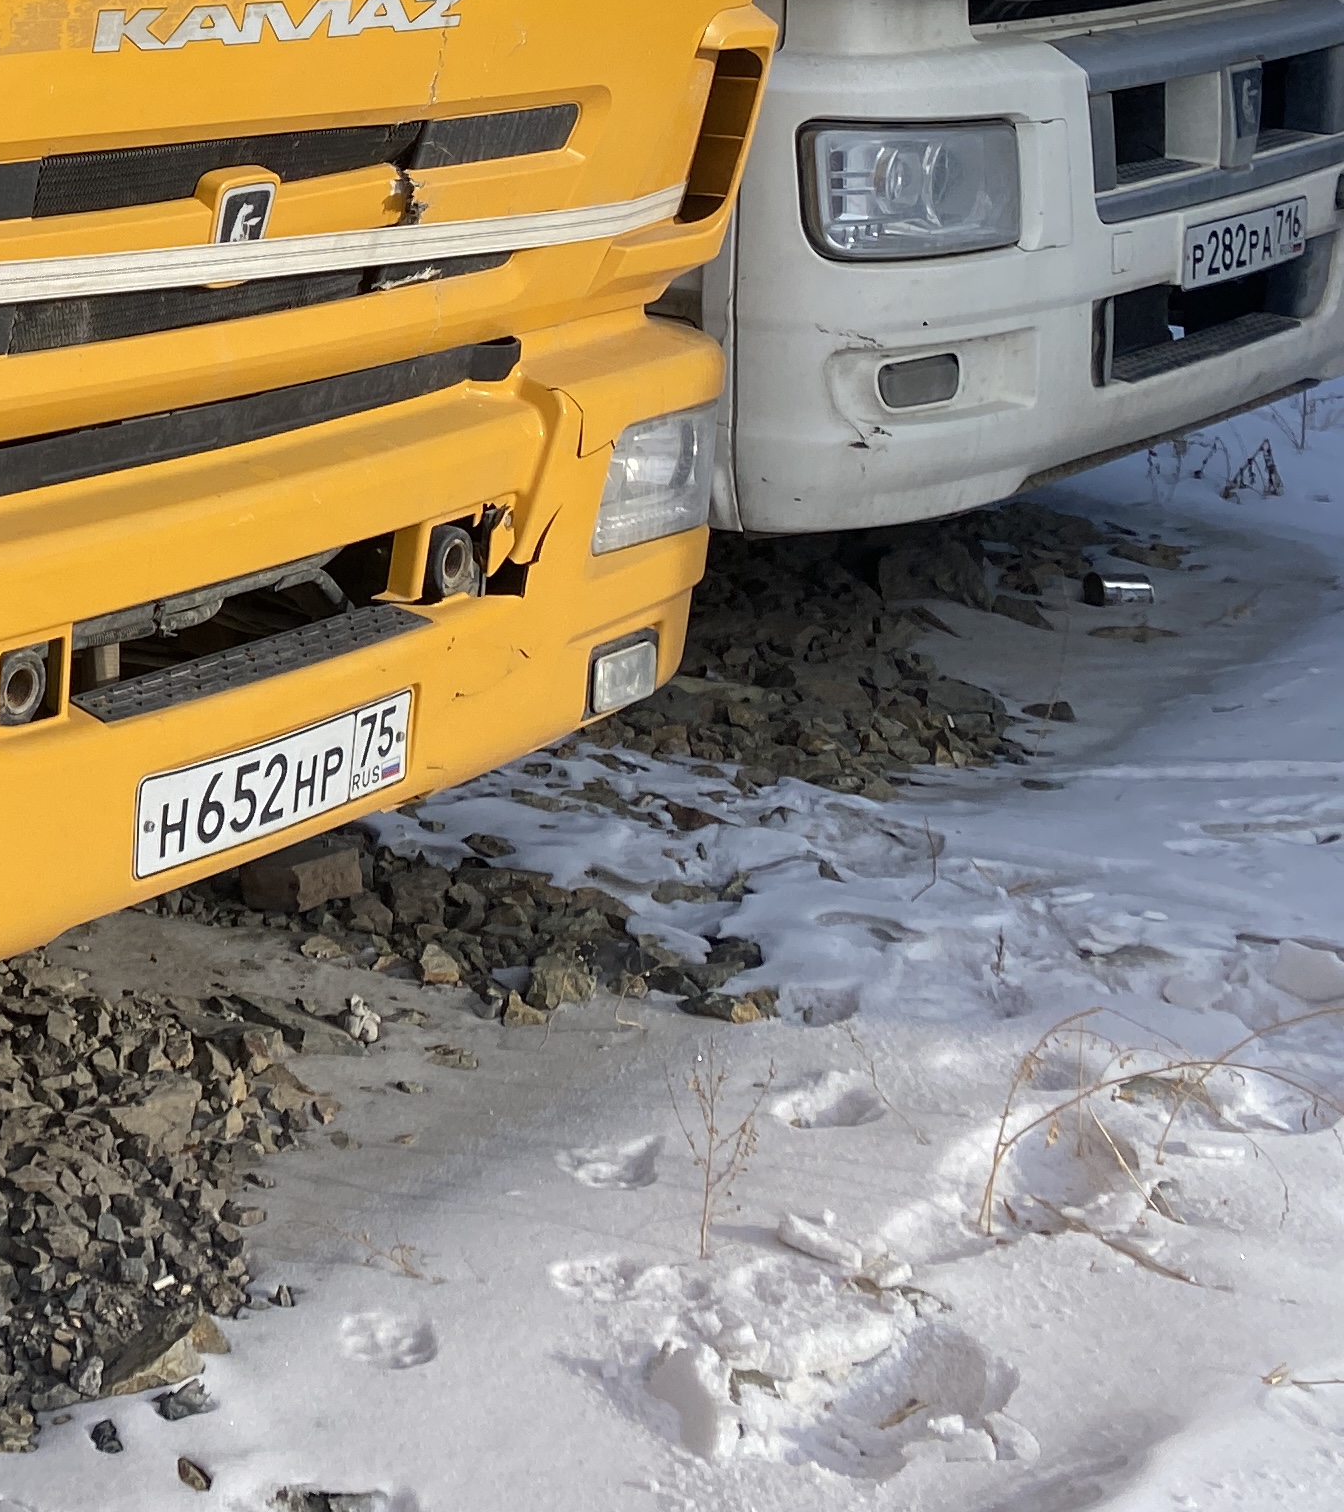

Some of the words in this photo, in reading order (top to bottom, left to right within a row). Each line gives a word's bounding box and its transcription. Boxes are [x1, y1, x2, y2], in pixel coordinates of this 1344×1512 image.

[1276, 205, 1301, 244] 716
[159, 746, 343, 858] Н652НР
[360, 705, 397, 768] 75
[351, 764, 380, 792] RUS
